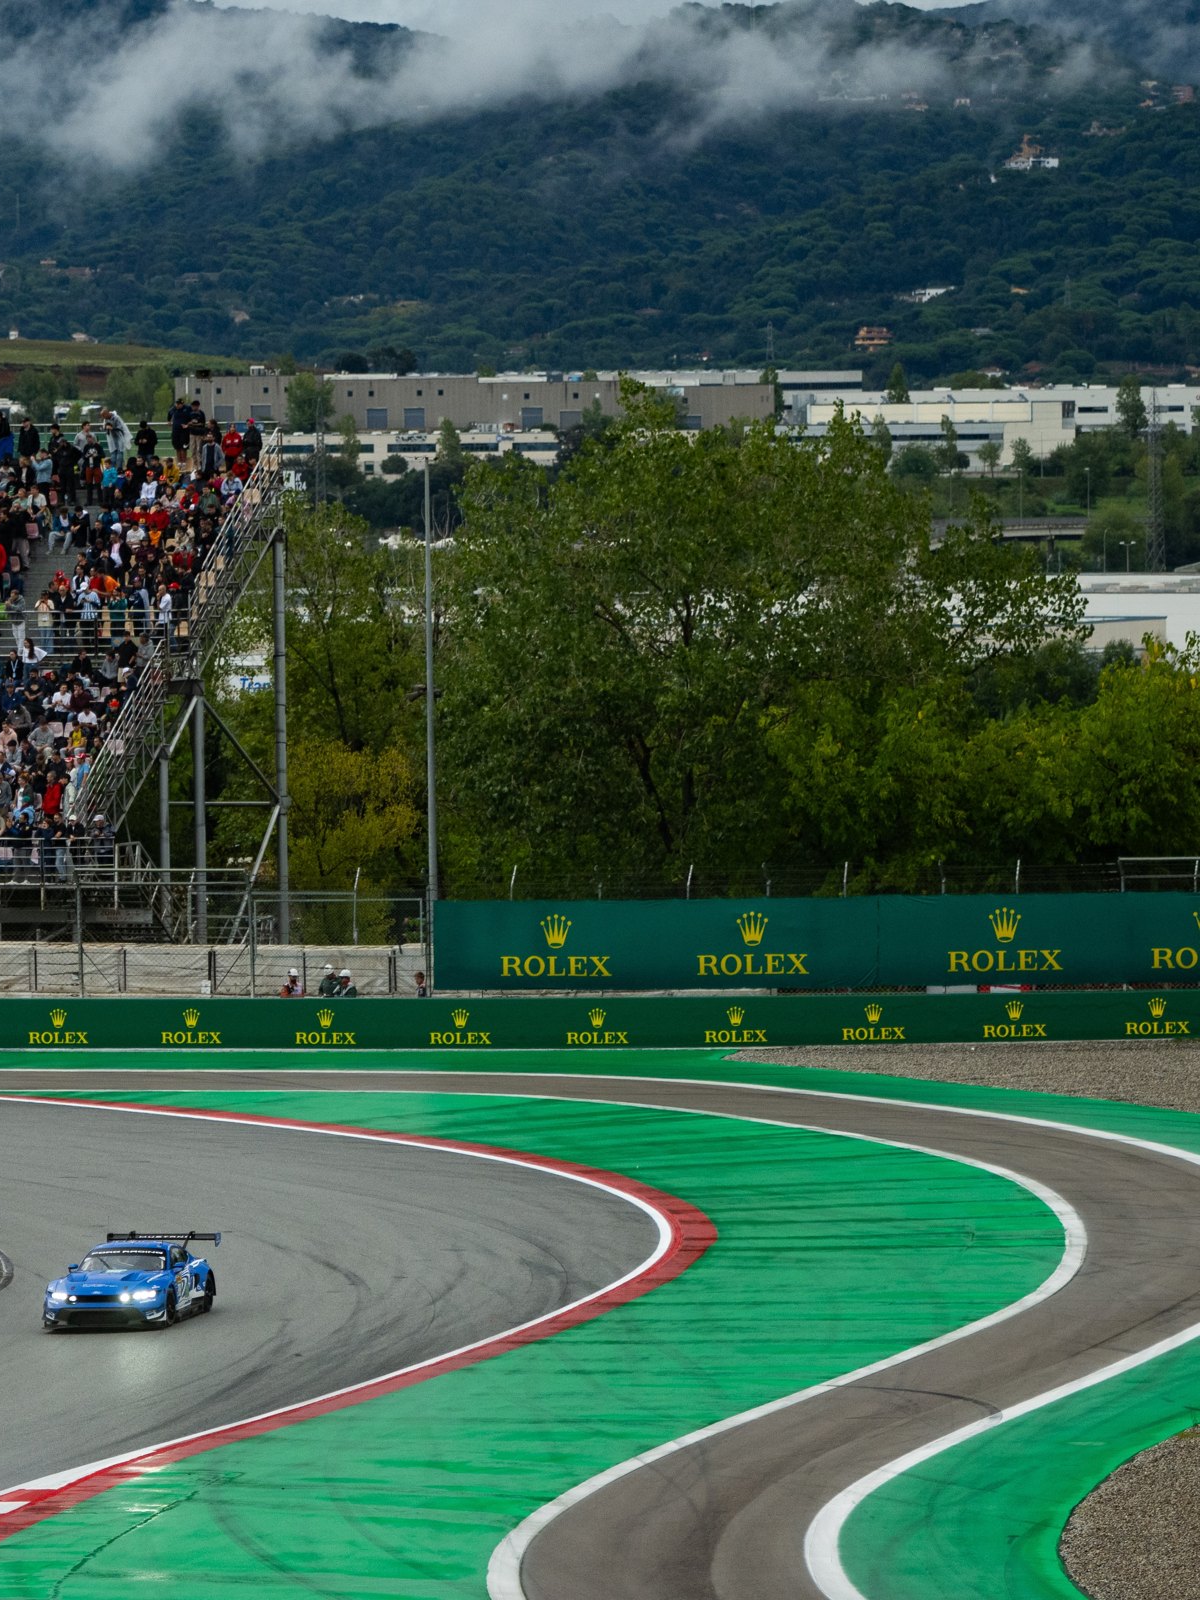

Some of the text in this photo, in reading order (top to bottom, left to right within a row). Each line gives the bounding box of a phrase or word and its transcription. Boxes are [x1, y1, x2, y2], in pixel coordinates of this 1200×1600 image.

[697, 953, 808, 975] ROLEX
[948, 949, 1062, 972] ROLEX
[1151, 947, 1198, 969] RO
[500, 955, 611, 977] ROLEX
[842, 1027, 905, 1041] ROLEX
[983, 1024, 1046, 1038] ROLEX
[1125, 1021, 1190, 1035] ROLEX
[29, 1031, 88, 1044] ROLEX
[161, 1031, 221, 1044] ROLEX
[295, 1031, 356, 1045] ROLEX
[430, 1032, 491, 1045] ROLEX
[567, 1031, 628, 1045] ROLEX
[705, 1029, 767, 1043] ROLEX
